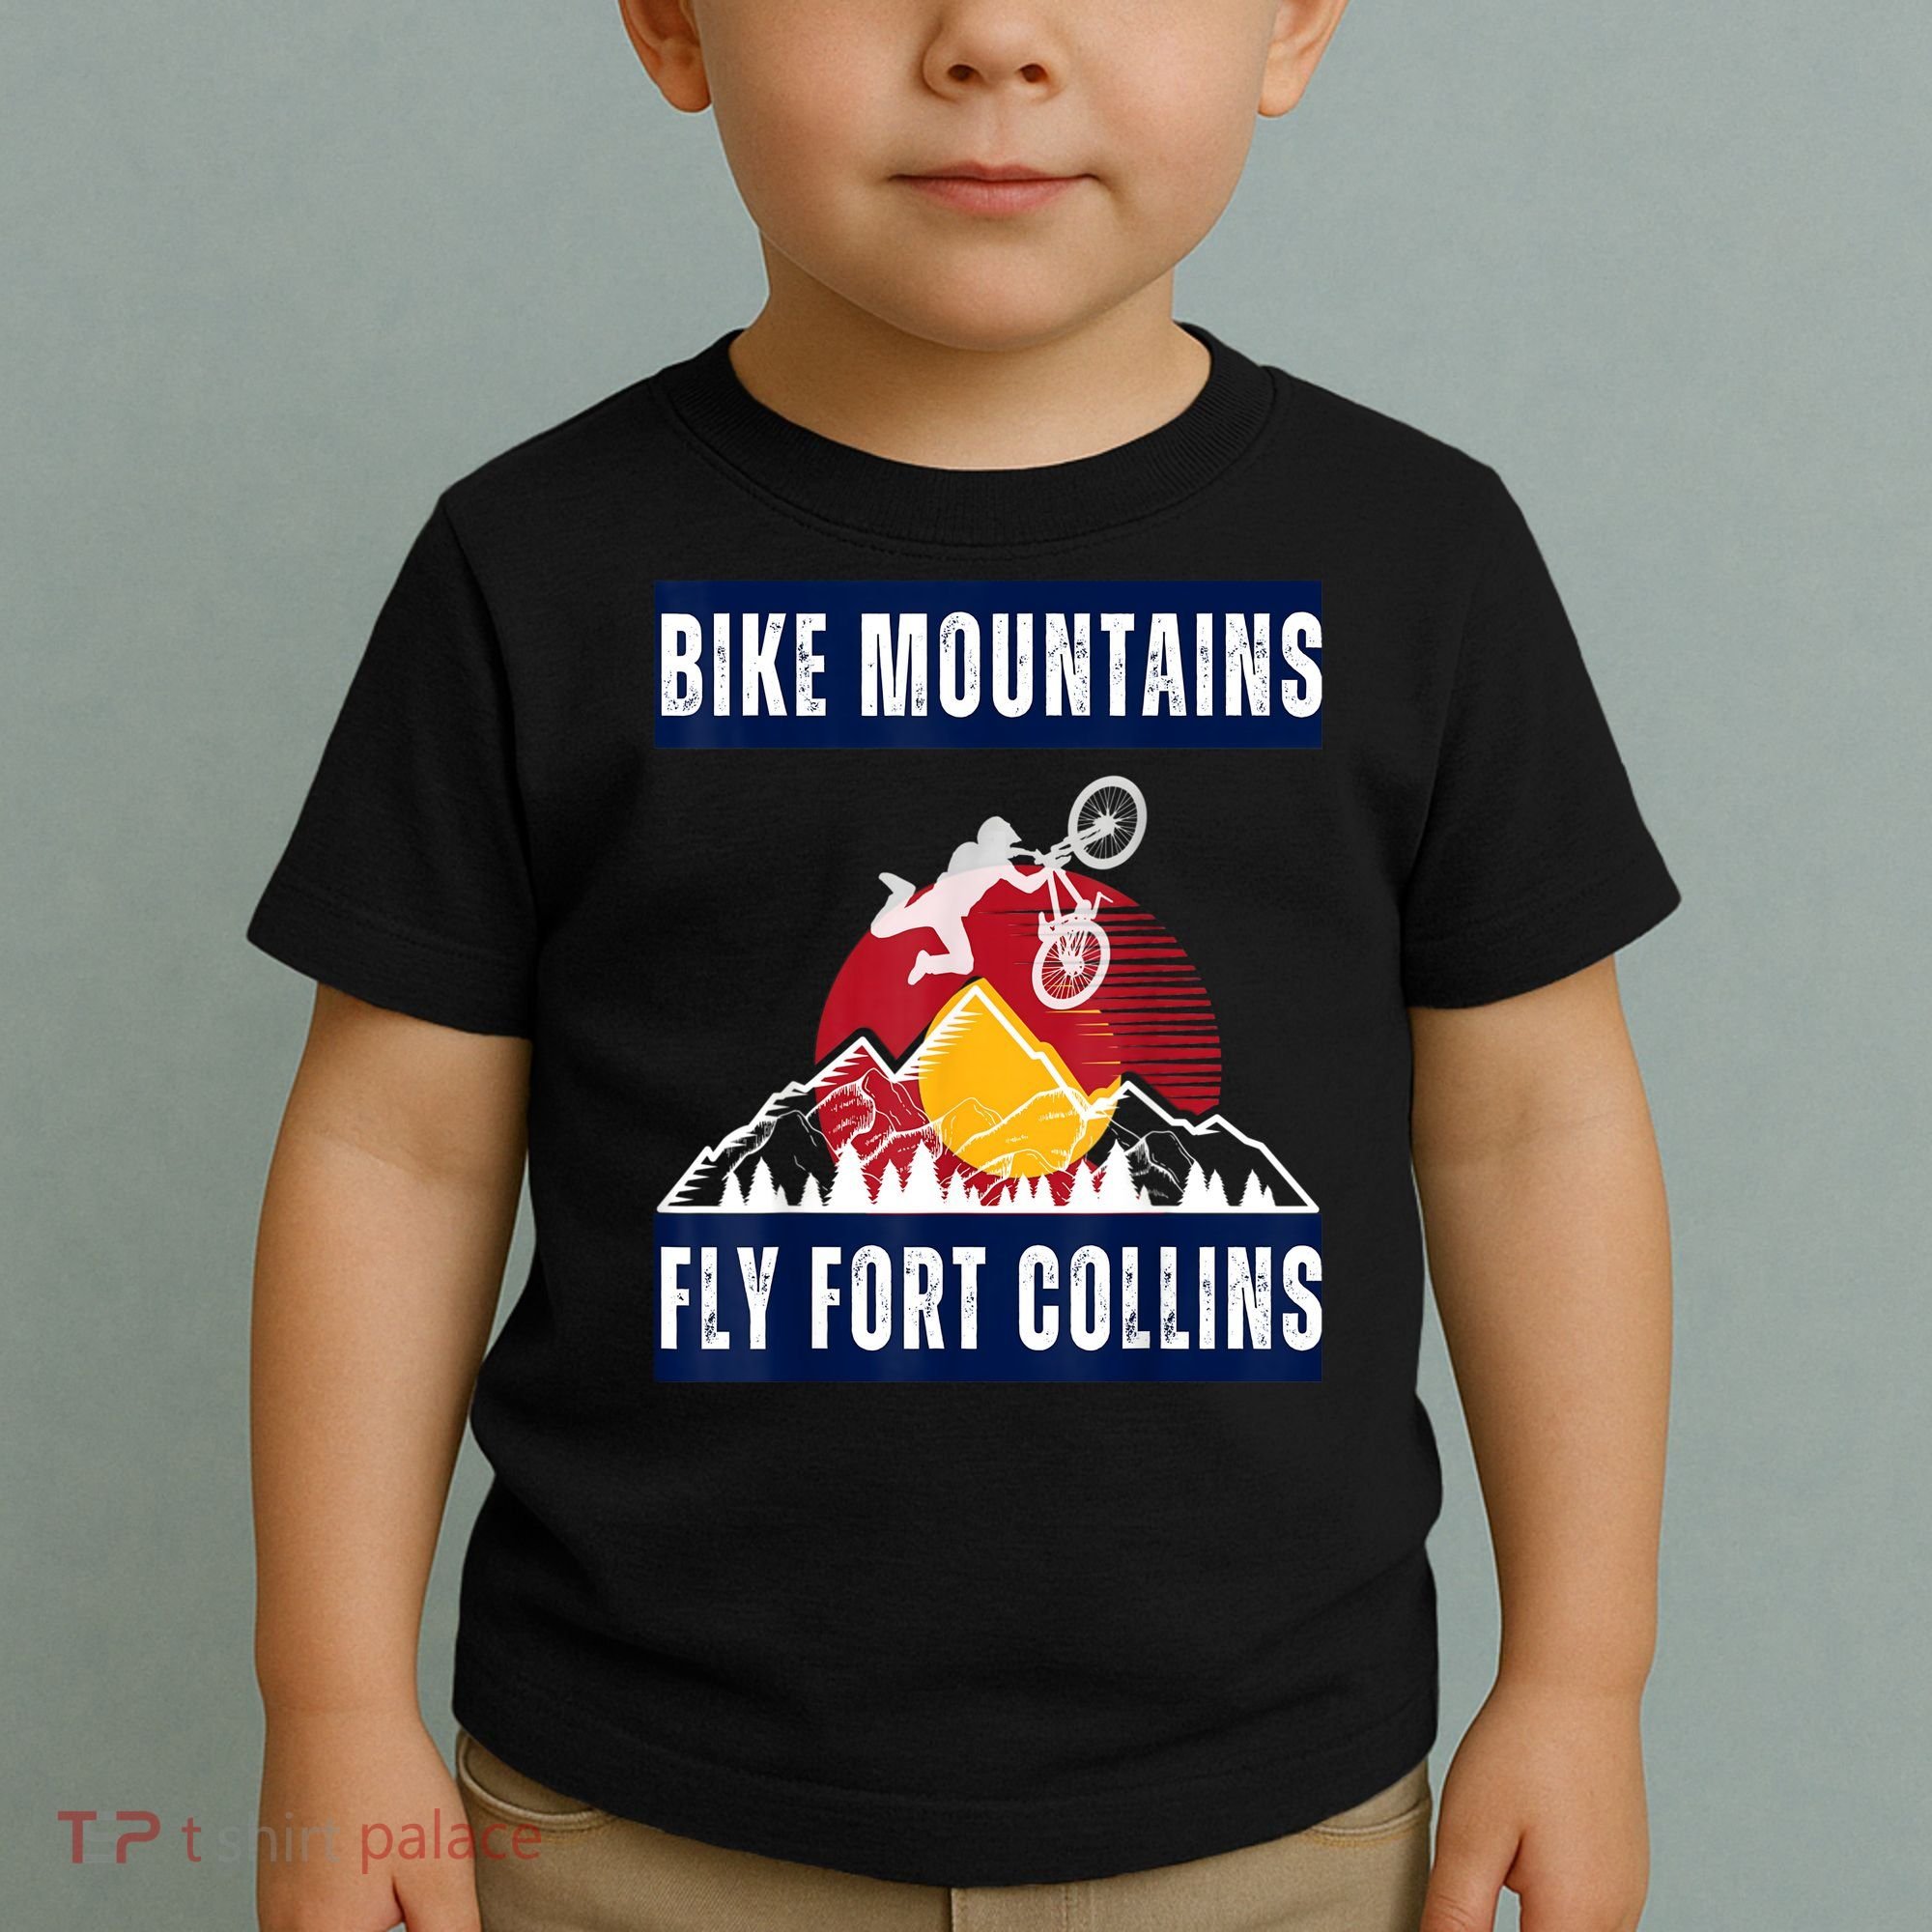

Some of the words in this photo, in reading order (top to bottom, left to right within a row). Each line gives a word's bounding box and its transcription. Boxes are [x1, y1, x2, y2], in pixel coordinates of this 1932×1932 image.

[660, 612, 826, 717] BIKE
[861, 611, 1322, 718] MOUNTAINS
[659, 1245, 779, 1350] FLY
[811, 1244, 985, 1350] FORT
[1018, 1244, 1322, 1350] COLLINS
